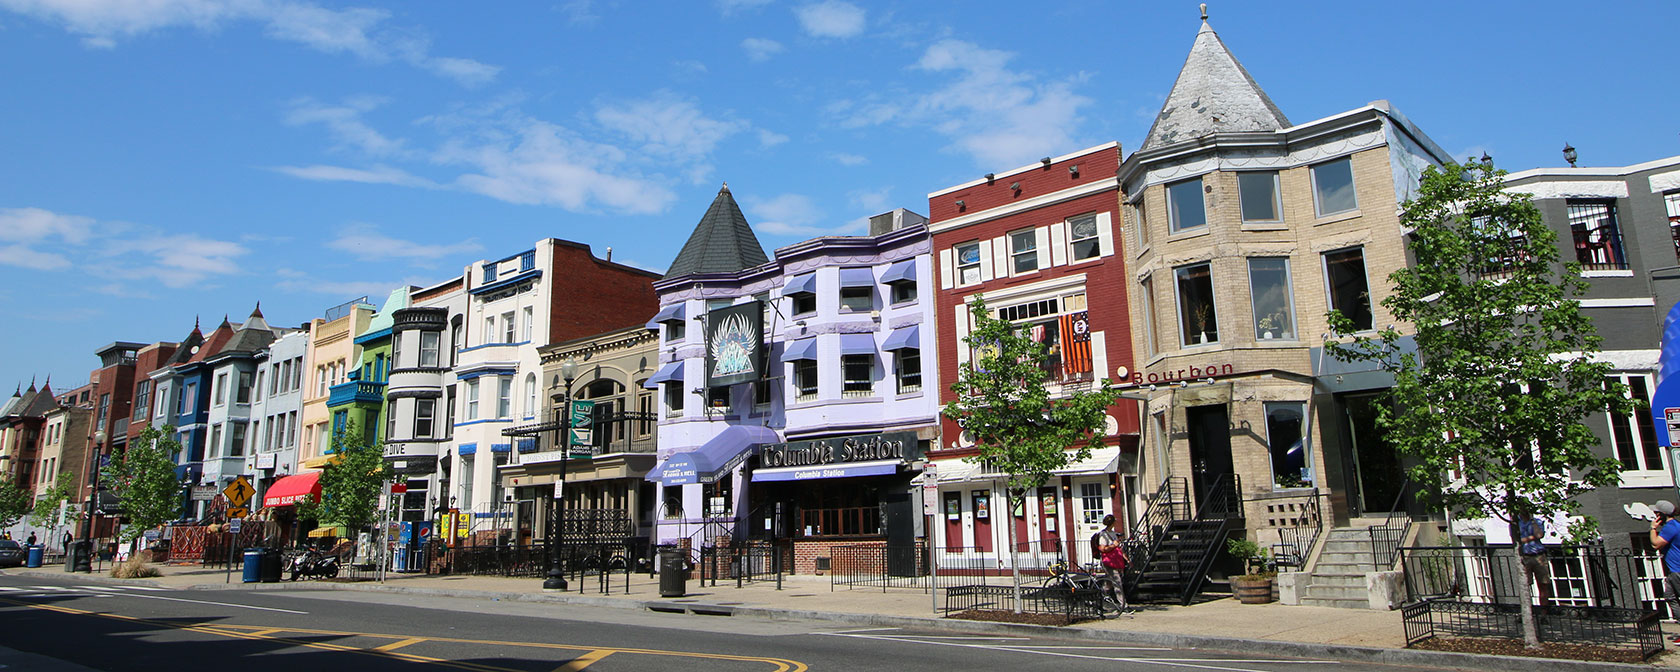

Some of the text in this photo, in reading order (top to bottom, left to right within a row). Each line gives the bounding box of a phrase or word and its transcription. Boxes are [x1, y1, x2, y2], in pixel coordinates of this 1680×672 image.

[1132, 363, 1233, 385] Bourbon
[572, 404, 593, 446] LIVE
[389, 443, 406, 455] DIVE
[763, 435, 904, 467] Columbia Station
[795, 469, 845, 479] Columbia Station
[265, 497, 281, 506] JUMBO
[281, 495, 294, 504] SLICE
